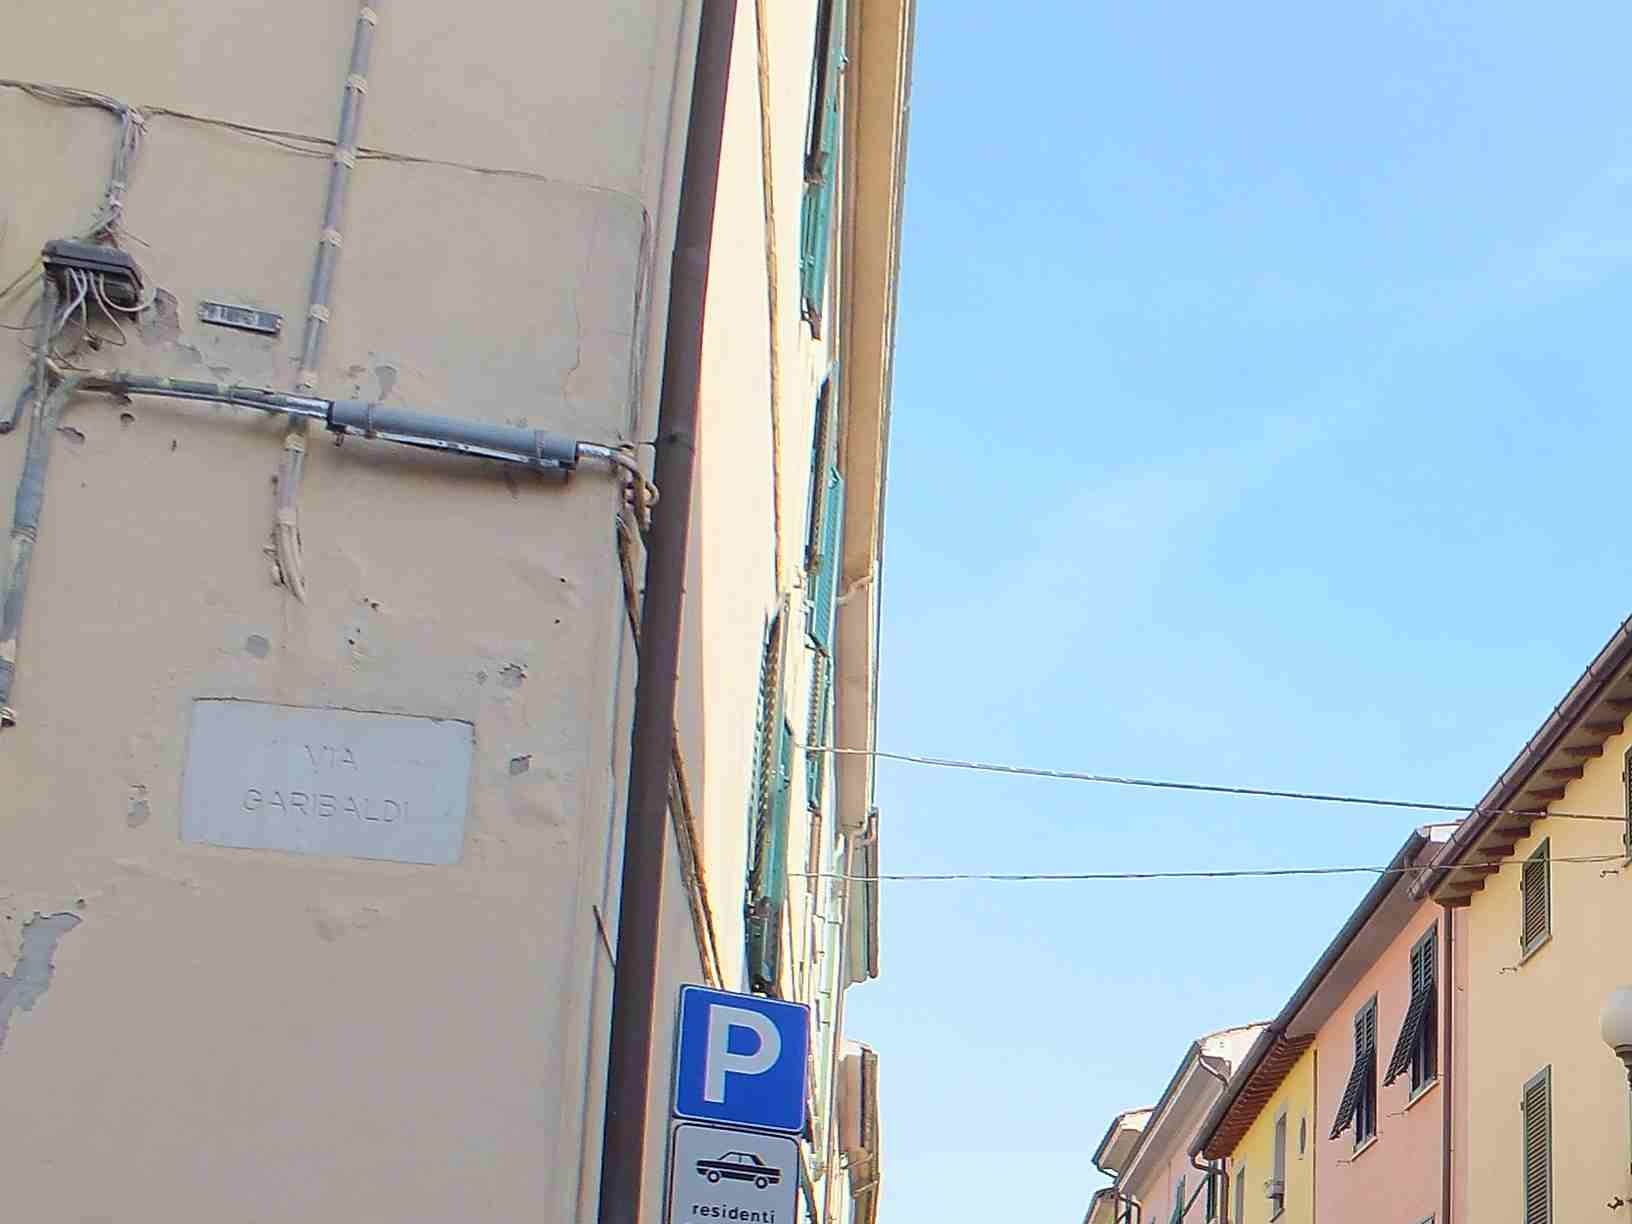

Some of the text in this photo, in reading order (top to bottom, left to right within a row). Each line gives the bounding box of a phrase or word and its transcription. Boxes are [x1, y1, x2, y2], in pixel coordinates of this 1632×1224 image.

[304, 744, 360, 772] VIA
[243, 787, 410, 824] GARIBALDI
[704, 1003, 782, 1104] P
[692, 1204, 776, 1224] residenti
